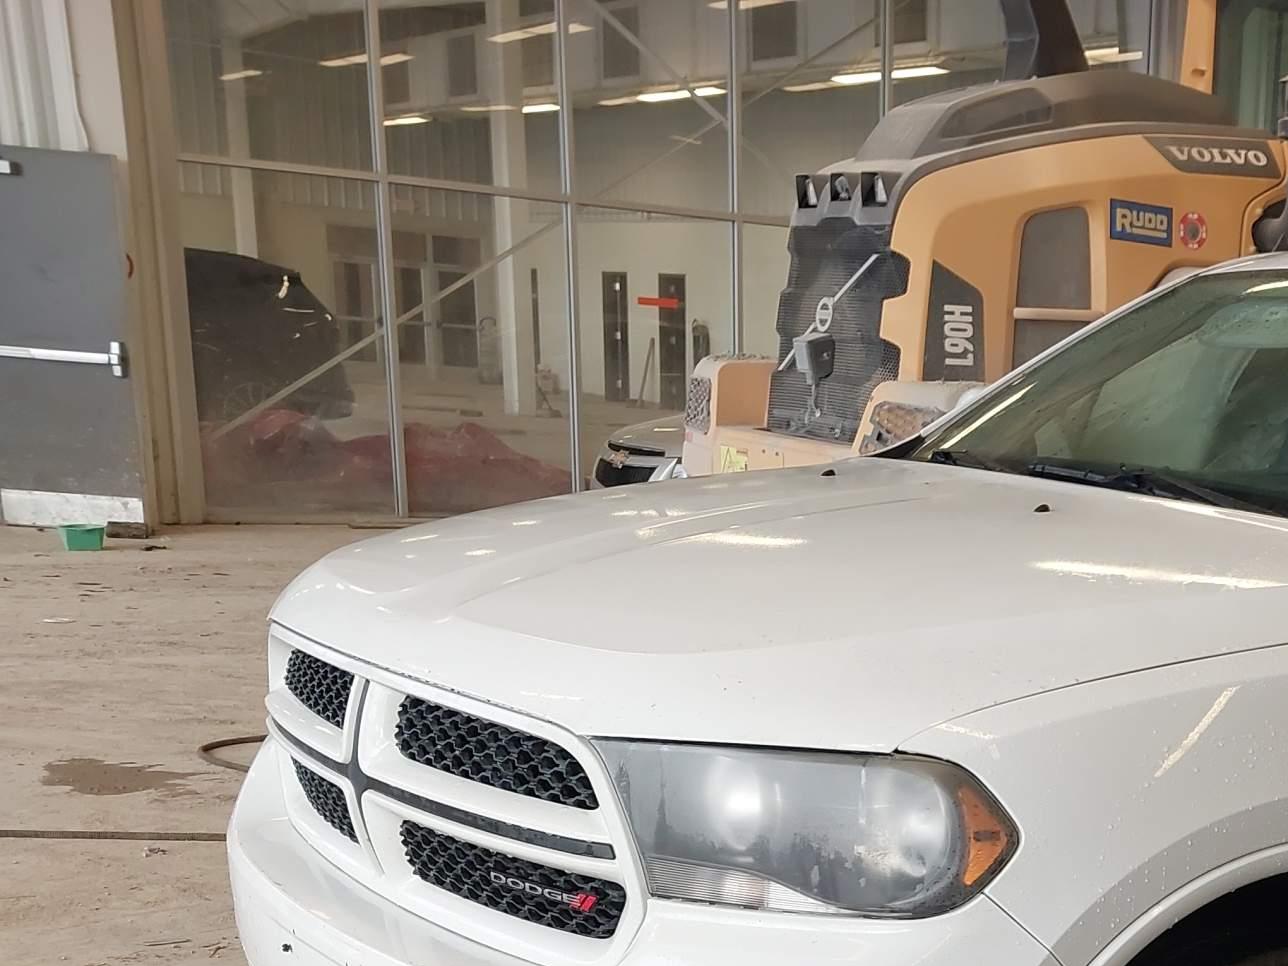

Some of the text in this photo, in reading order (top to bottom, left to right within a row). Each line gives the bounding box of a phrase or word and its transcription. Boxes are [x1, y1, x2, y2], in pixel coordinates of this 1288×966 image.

[1168, 145, 1268, 167] VOLVO
[1116, 207, 1168, 232] RUDD
[943, 304, 974, 366] L90H
[490, 871, 582, 907] DODGE
